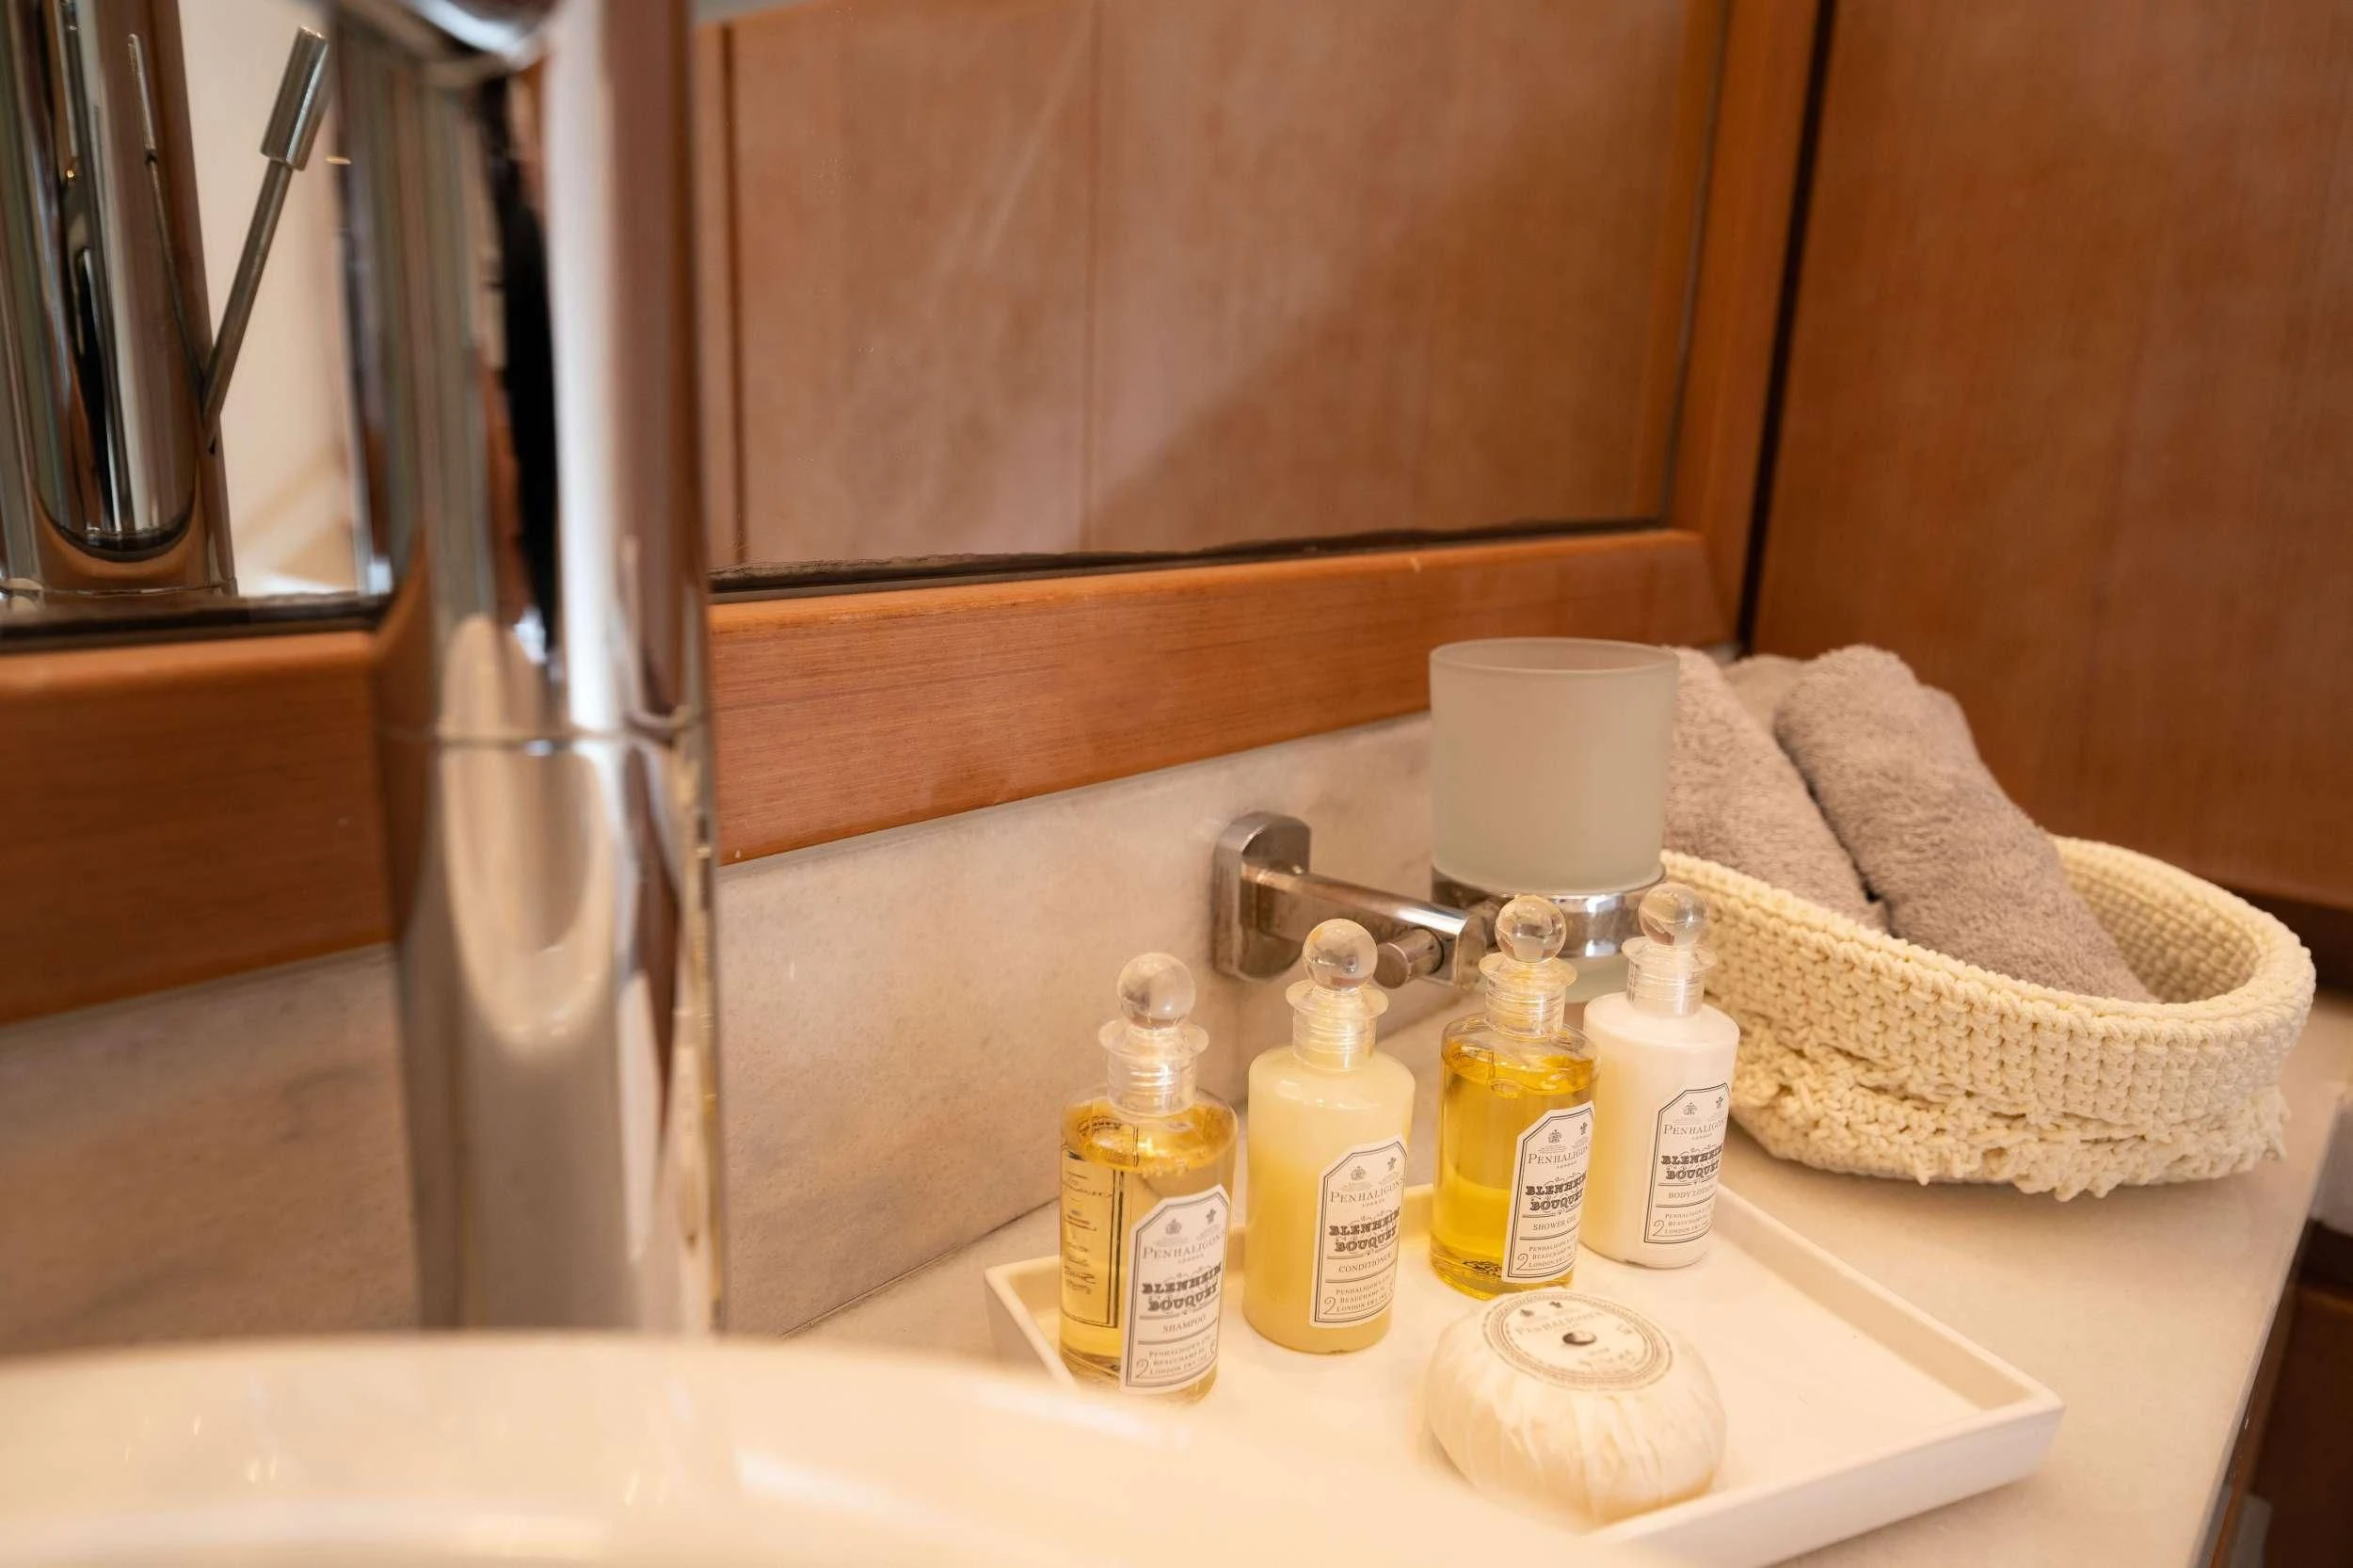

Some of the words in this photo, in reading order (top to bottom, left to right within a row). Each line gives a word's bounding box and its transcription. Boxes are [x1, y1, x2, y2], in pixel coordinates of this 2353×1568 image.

[1661, 1143, 1722, 1165] BLENHEIM
[1665, 1160, 1720, 1180] BOUQUET
[1526, 1170, 1587, 1195] BLENHEIM
[1529, 1188, 1584, 1211] BOUQUET
[1668, 1190, 1691, 1199] BODY
[1329, 1207, 1401, 1236] BLENHEIM
[1532, 1219, 1565, 1231] SHOWER
[1653, 1220, 1665, 1236] 2
[1335, 1225, 1397, 1252] BOUQUET
[1516, 1253, 1529, 1271] 2
[1142, 1261, 1222, 1294] BLENHEIM
[1147, 1284, 1218, 1312] BOUQUET
[1323, 1297, 1337, 1314] 2
[1162, 1315, 1206, 1334] SHAMPOO
[1136, 1359, 1149, 1379] 2
